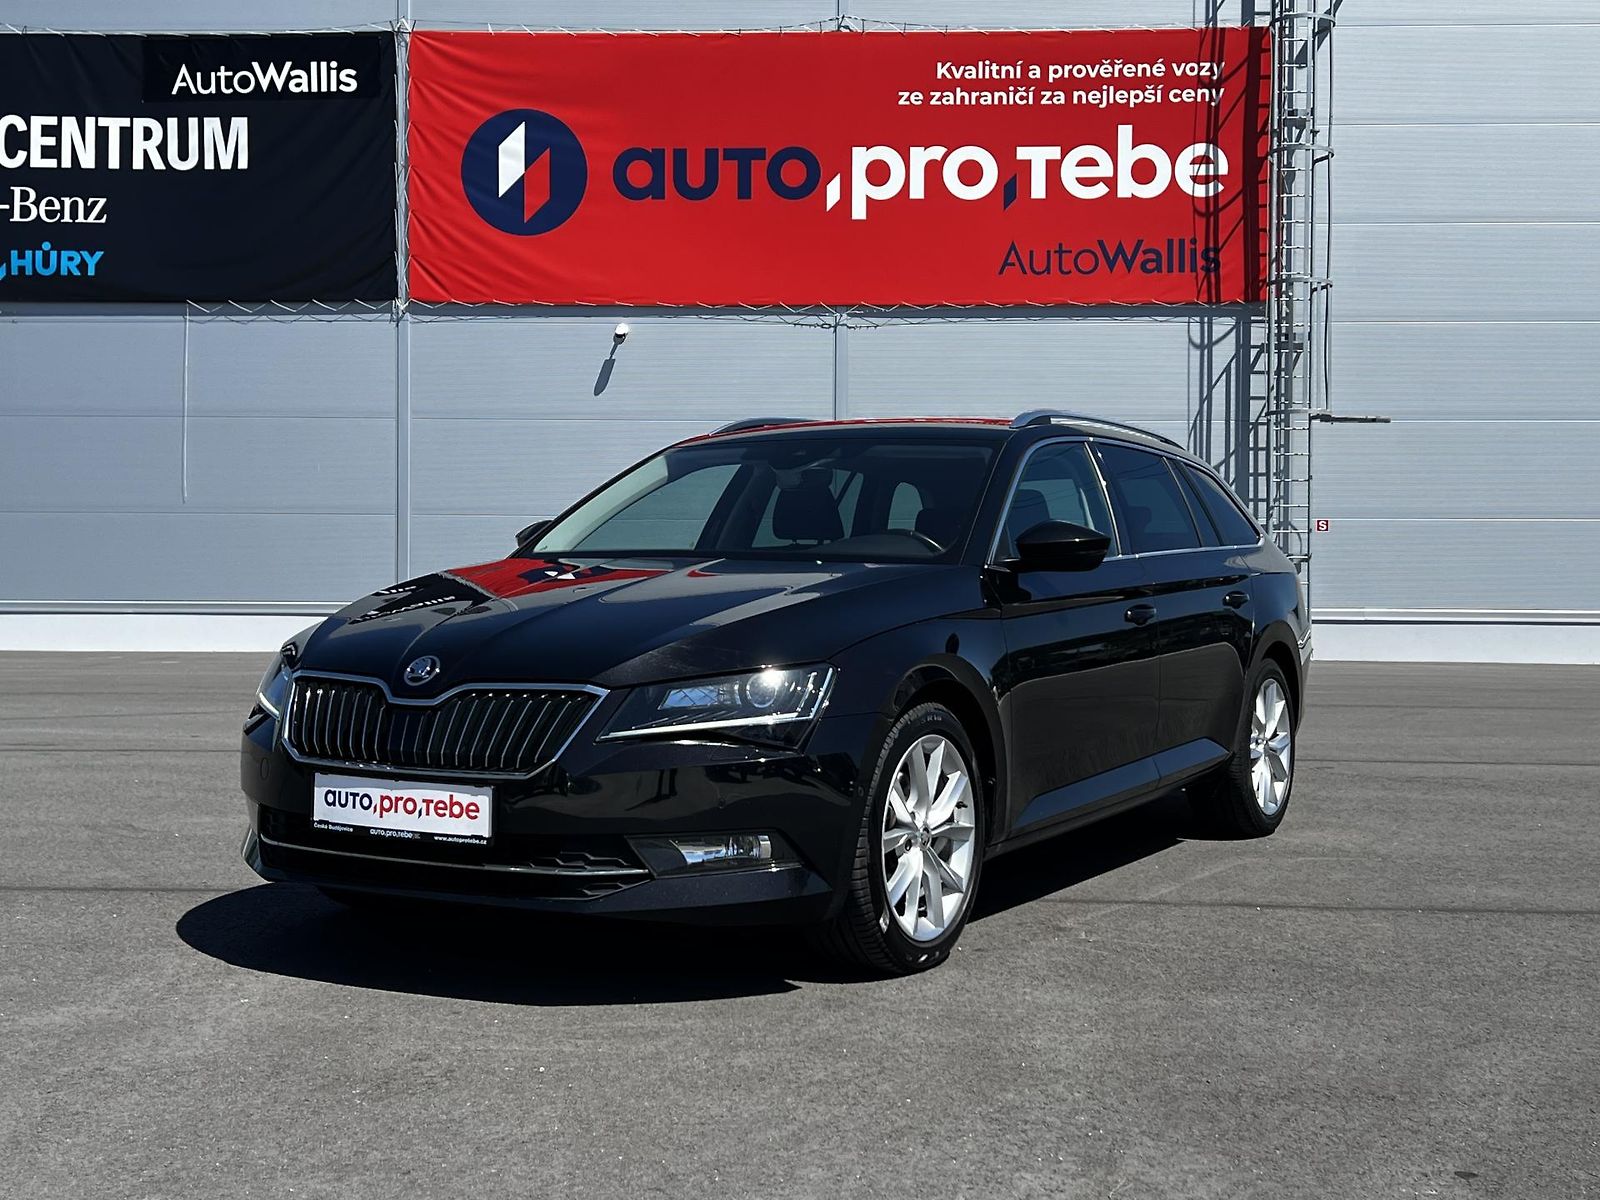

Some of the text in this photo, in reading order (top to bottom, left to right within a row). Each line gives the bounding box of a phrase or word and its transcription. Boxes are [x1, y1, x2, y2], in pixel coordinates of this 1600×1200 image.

[171, 61, 358, 95] AutoWallis
[936, 60, 1226, 84] Kvalitní a prověřené vozy
[897, 85, 1226, 109] ze zahraničí za nejlepší ceny
[0, 114, 249, 172] CENTRUM
[998, 238, 1222, 276] AutoWallis
[1317, 520, 1328, 531] S
